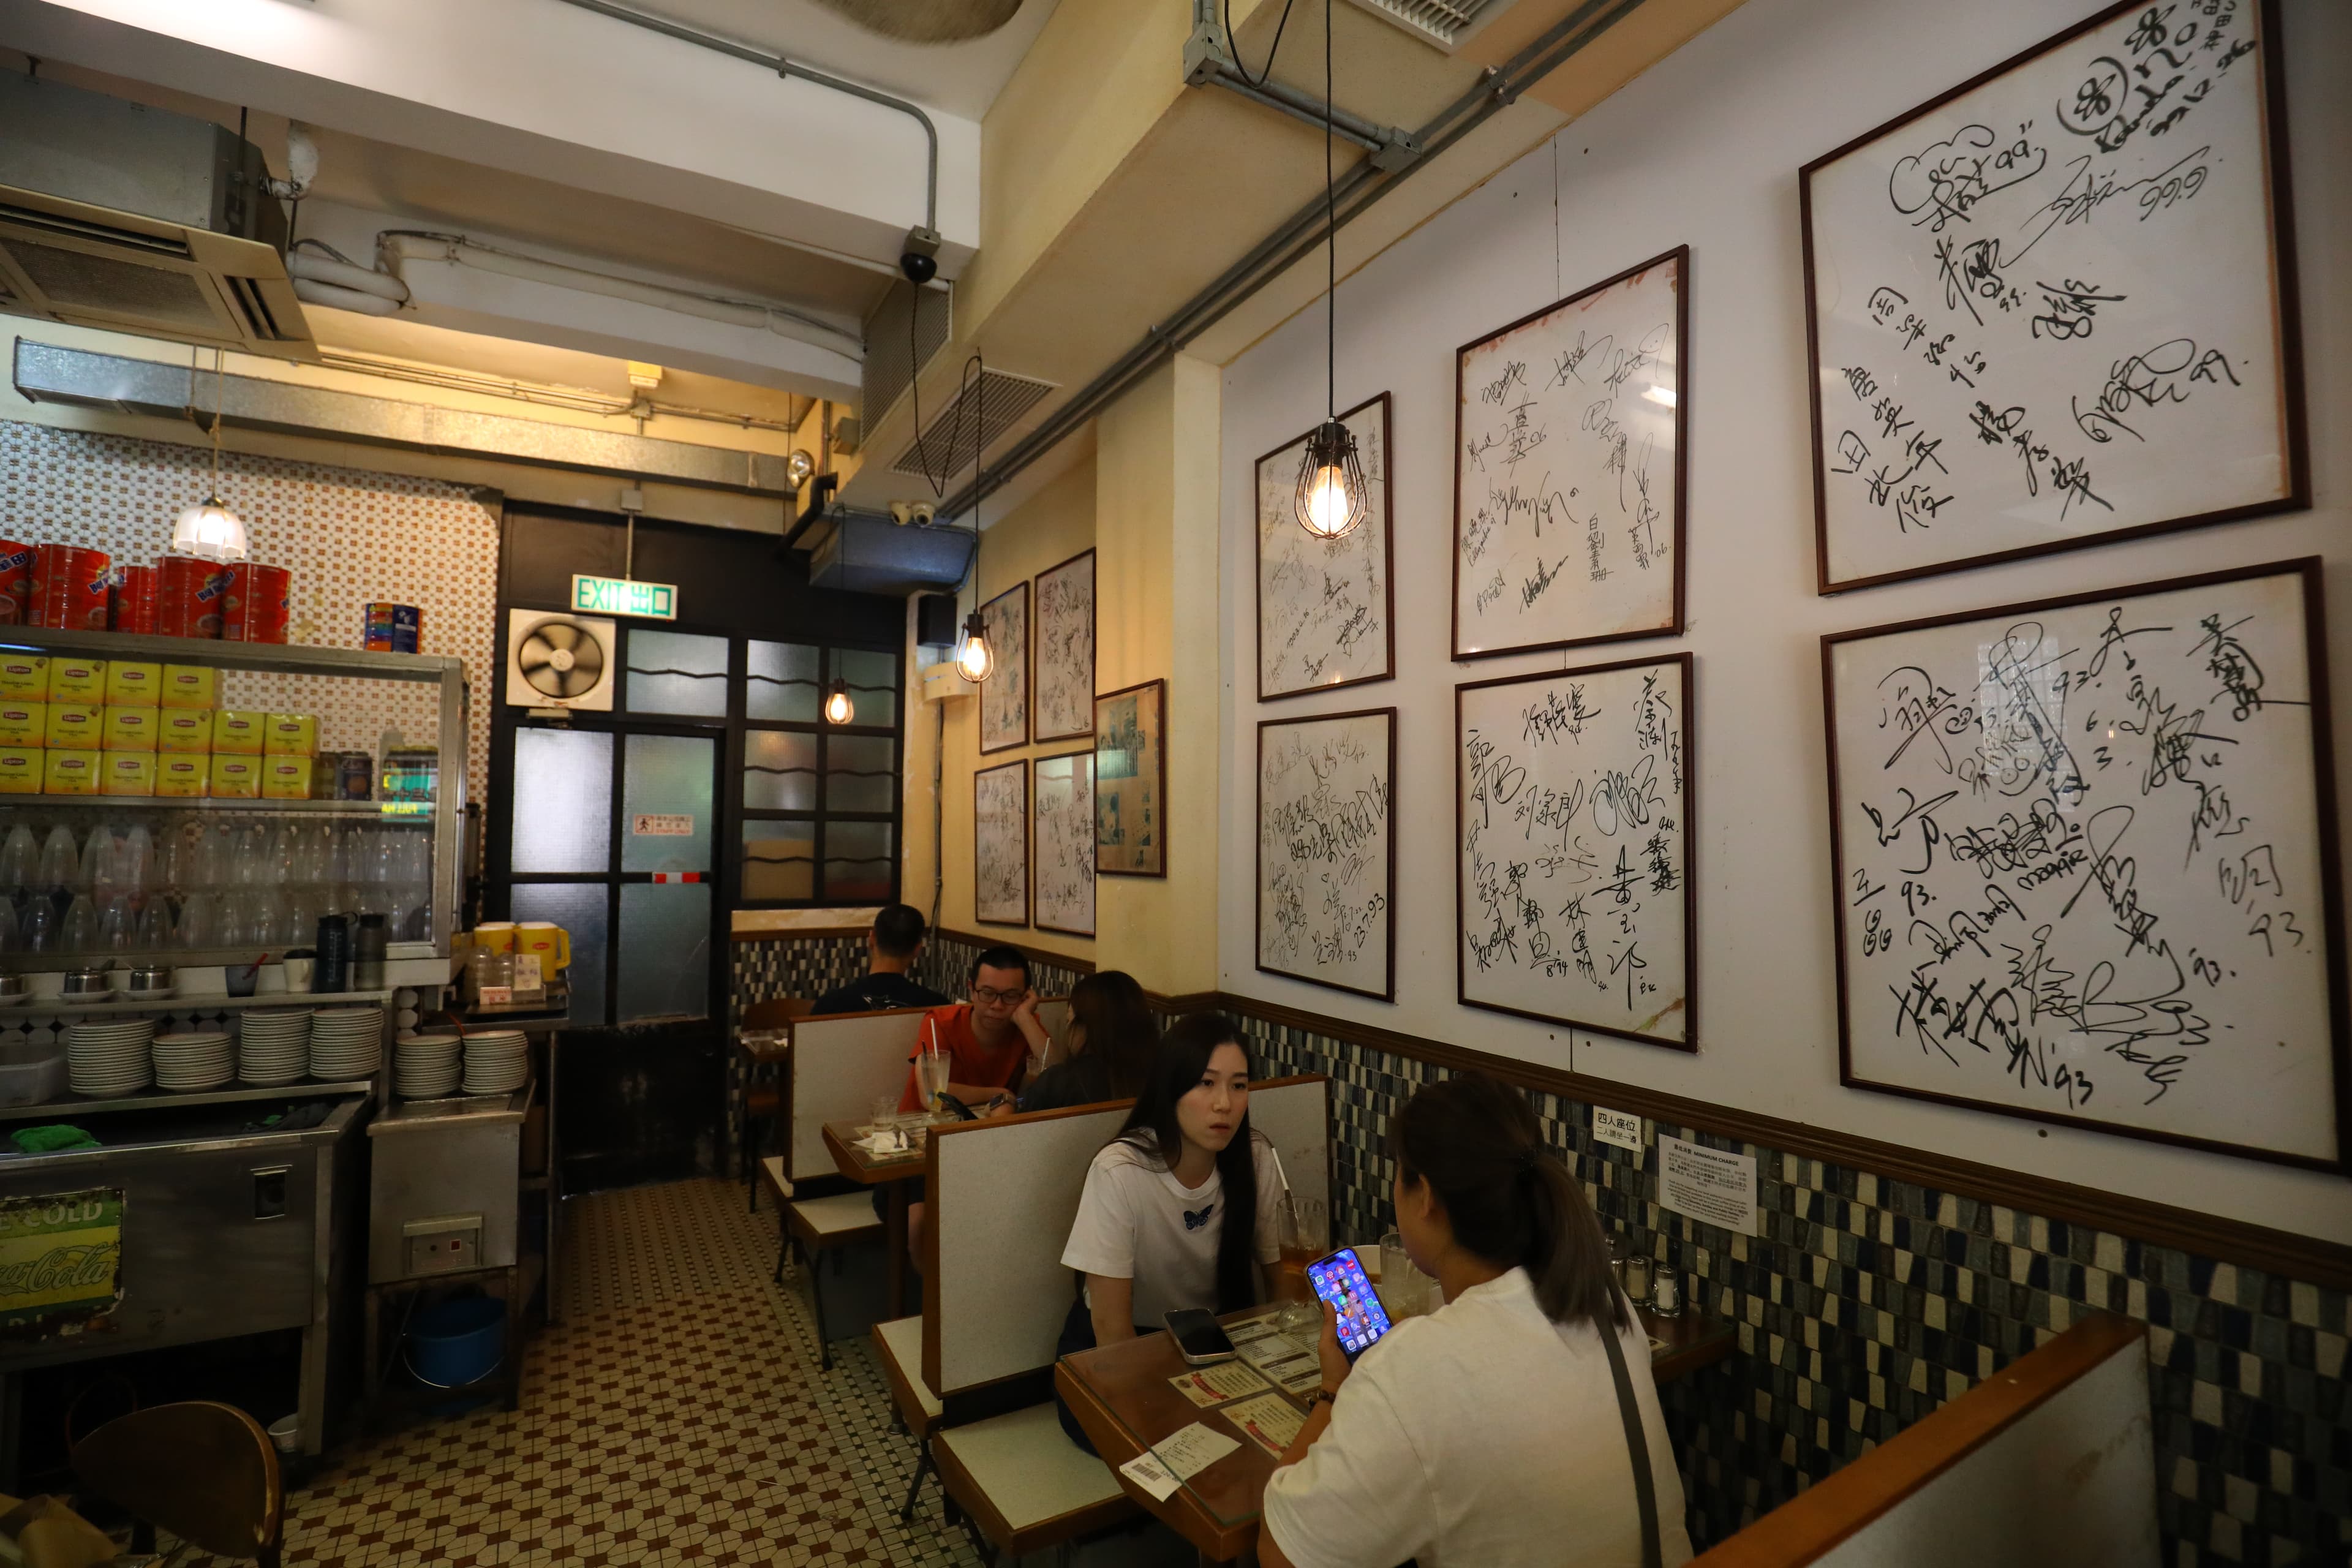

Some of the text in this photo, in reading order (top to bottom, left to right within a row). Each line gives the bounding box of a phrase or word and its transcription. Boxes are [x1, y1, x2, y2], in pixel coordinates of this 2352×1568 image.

[578, 578, 671, 616] EXIT 出口
[1598, 1112, 1635, 1132] 四人座位
[1597, 1126, 1637, 1144] 二人請坐一邊
[1694, 1151, 1718, 1163] MINIMUM
[1718, 1157, 1740, 1166] CHARGE
[24, 1201, 103, 1228] COLD
